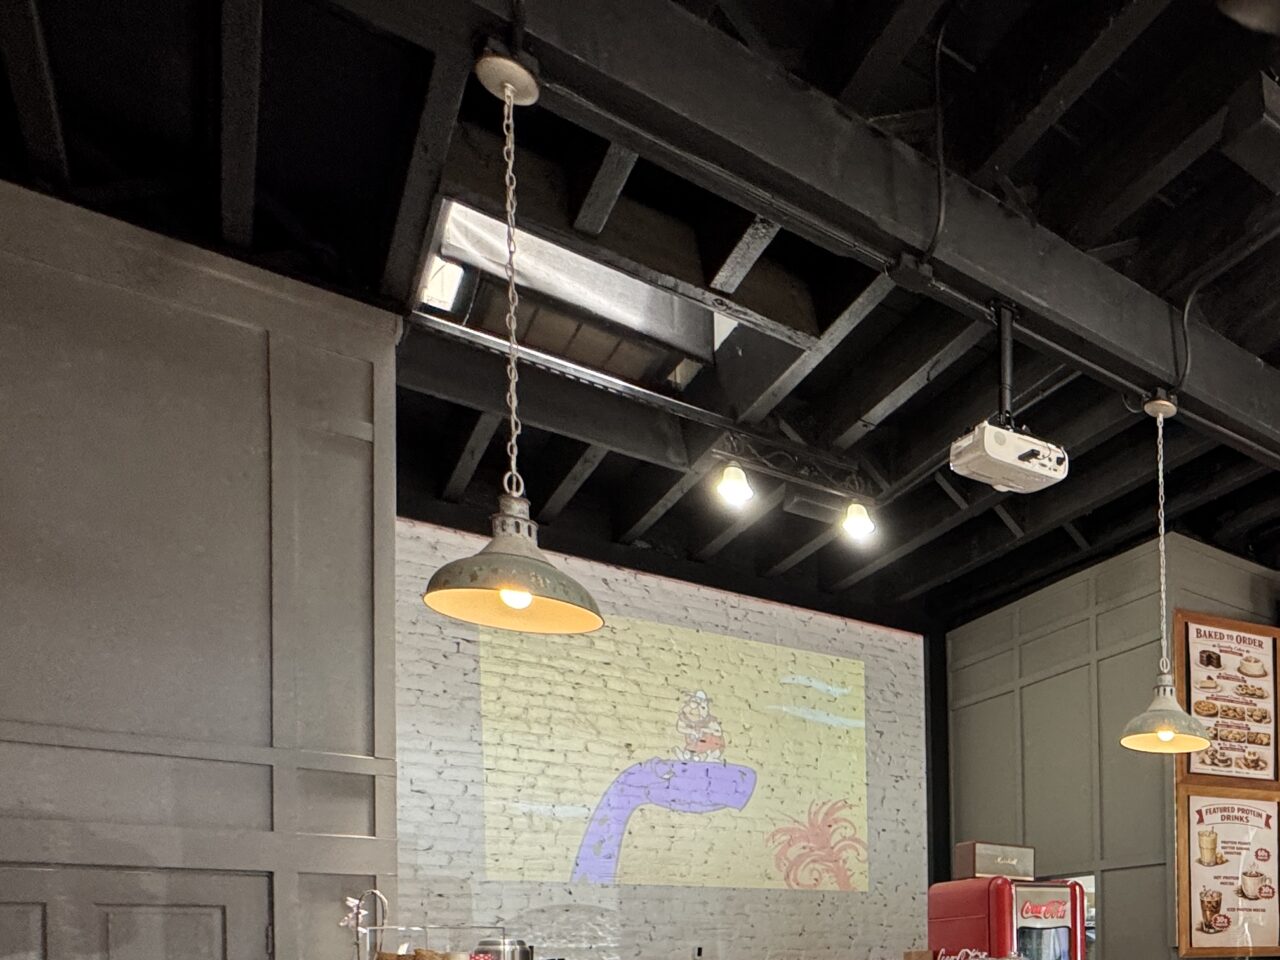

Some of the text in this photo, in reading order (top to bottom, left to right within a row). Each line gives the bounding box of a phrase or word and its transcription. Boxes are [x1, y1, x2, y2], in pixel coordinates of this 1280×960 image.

[1205, 806, 1263, 819] FEATURED PROTEIN
[1220, 814, 1250, 824] DRINKS
